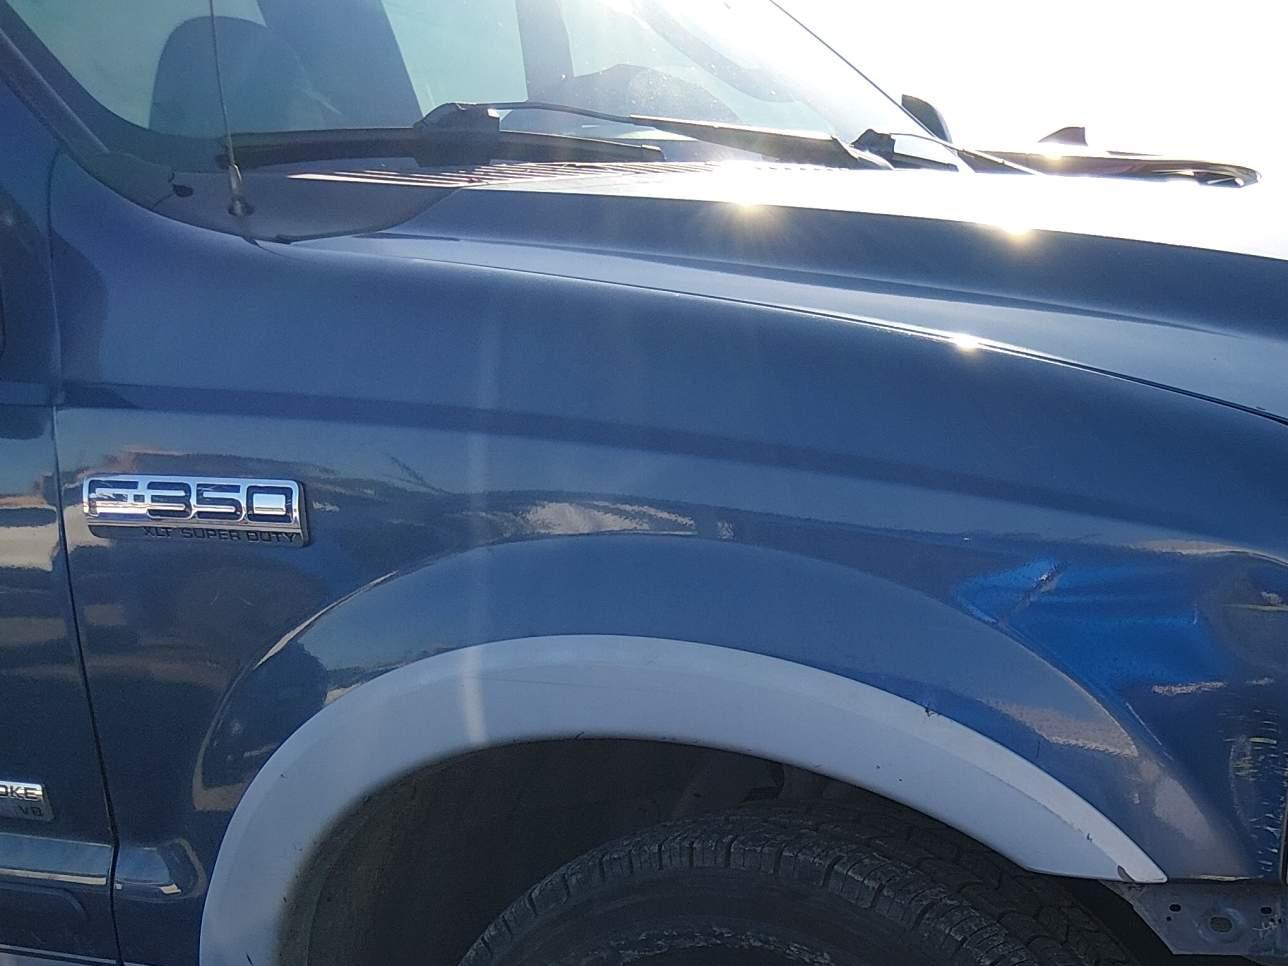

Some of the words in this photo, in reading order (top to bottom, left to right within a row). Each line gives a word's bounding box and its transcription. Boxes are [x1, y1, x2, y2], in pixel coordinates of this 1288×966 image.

[84, 477, 298, 525] F-350
[143, 526, 172, 538] XLT
[181, 528, 241, 542] SUPER
[247, 531, 297, 543] DUTY
